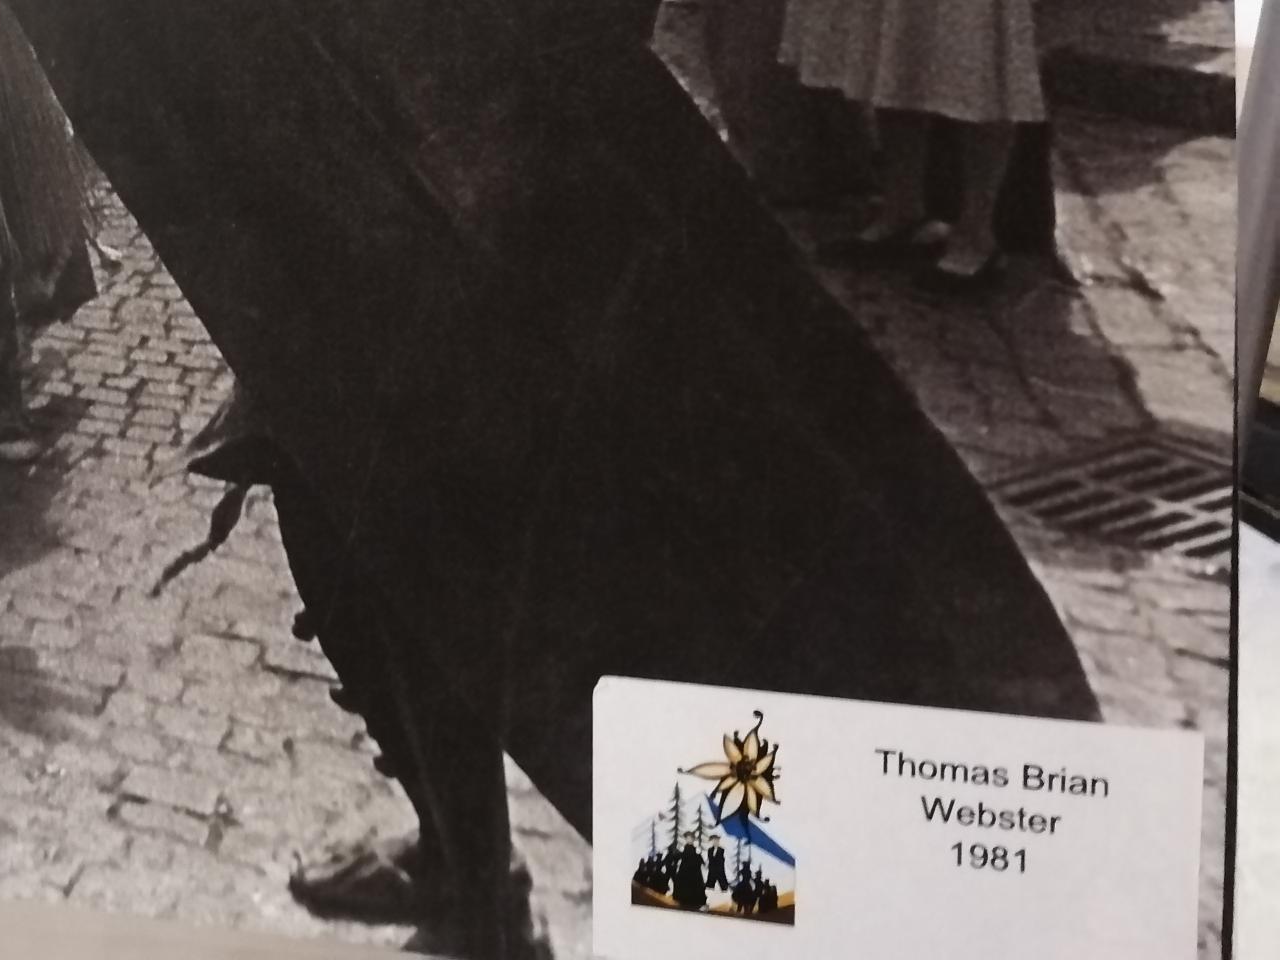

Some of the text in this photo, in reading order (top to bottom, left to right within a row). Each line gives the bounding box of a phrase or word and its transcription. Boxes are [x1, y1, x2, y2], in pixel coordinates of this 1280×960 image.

[875, 748, 1110, 797] Thomas Brian
[921, 795, 1062, 835] Webster
[950, 841, 1027, 873] 1981
